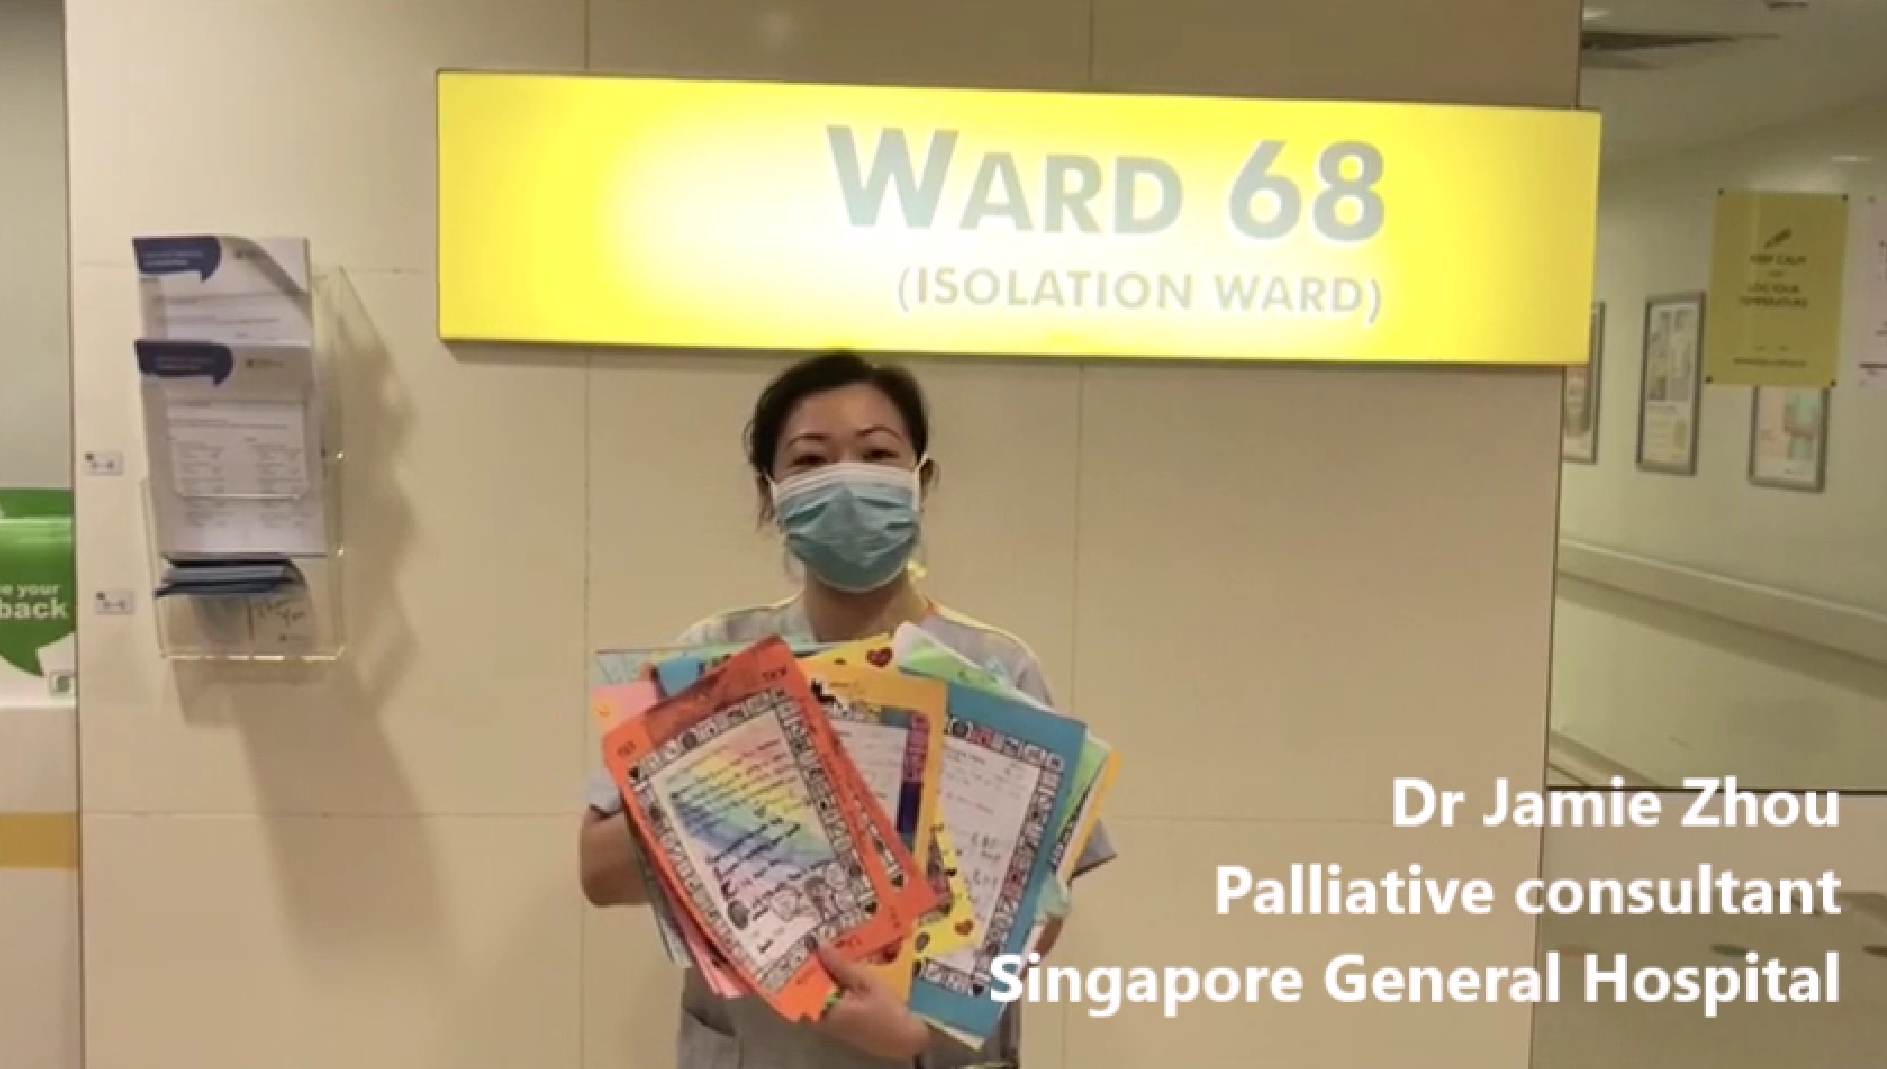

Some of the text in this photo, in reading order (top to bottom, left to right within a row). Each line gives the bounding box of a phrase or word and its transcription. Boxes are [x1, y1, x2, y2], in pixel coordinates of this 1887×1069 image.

[1229, 139, 1386, 242] 68
[898, 265, 1382, 324] (ISOLATION WARD)
[17, 584, 61, 600] your
